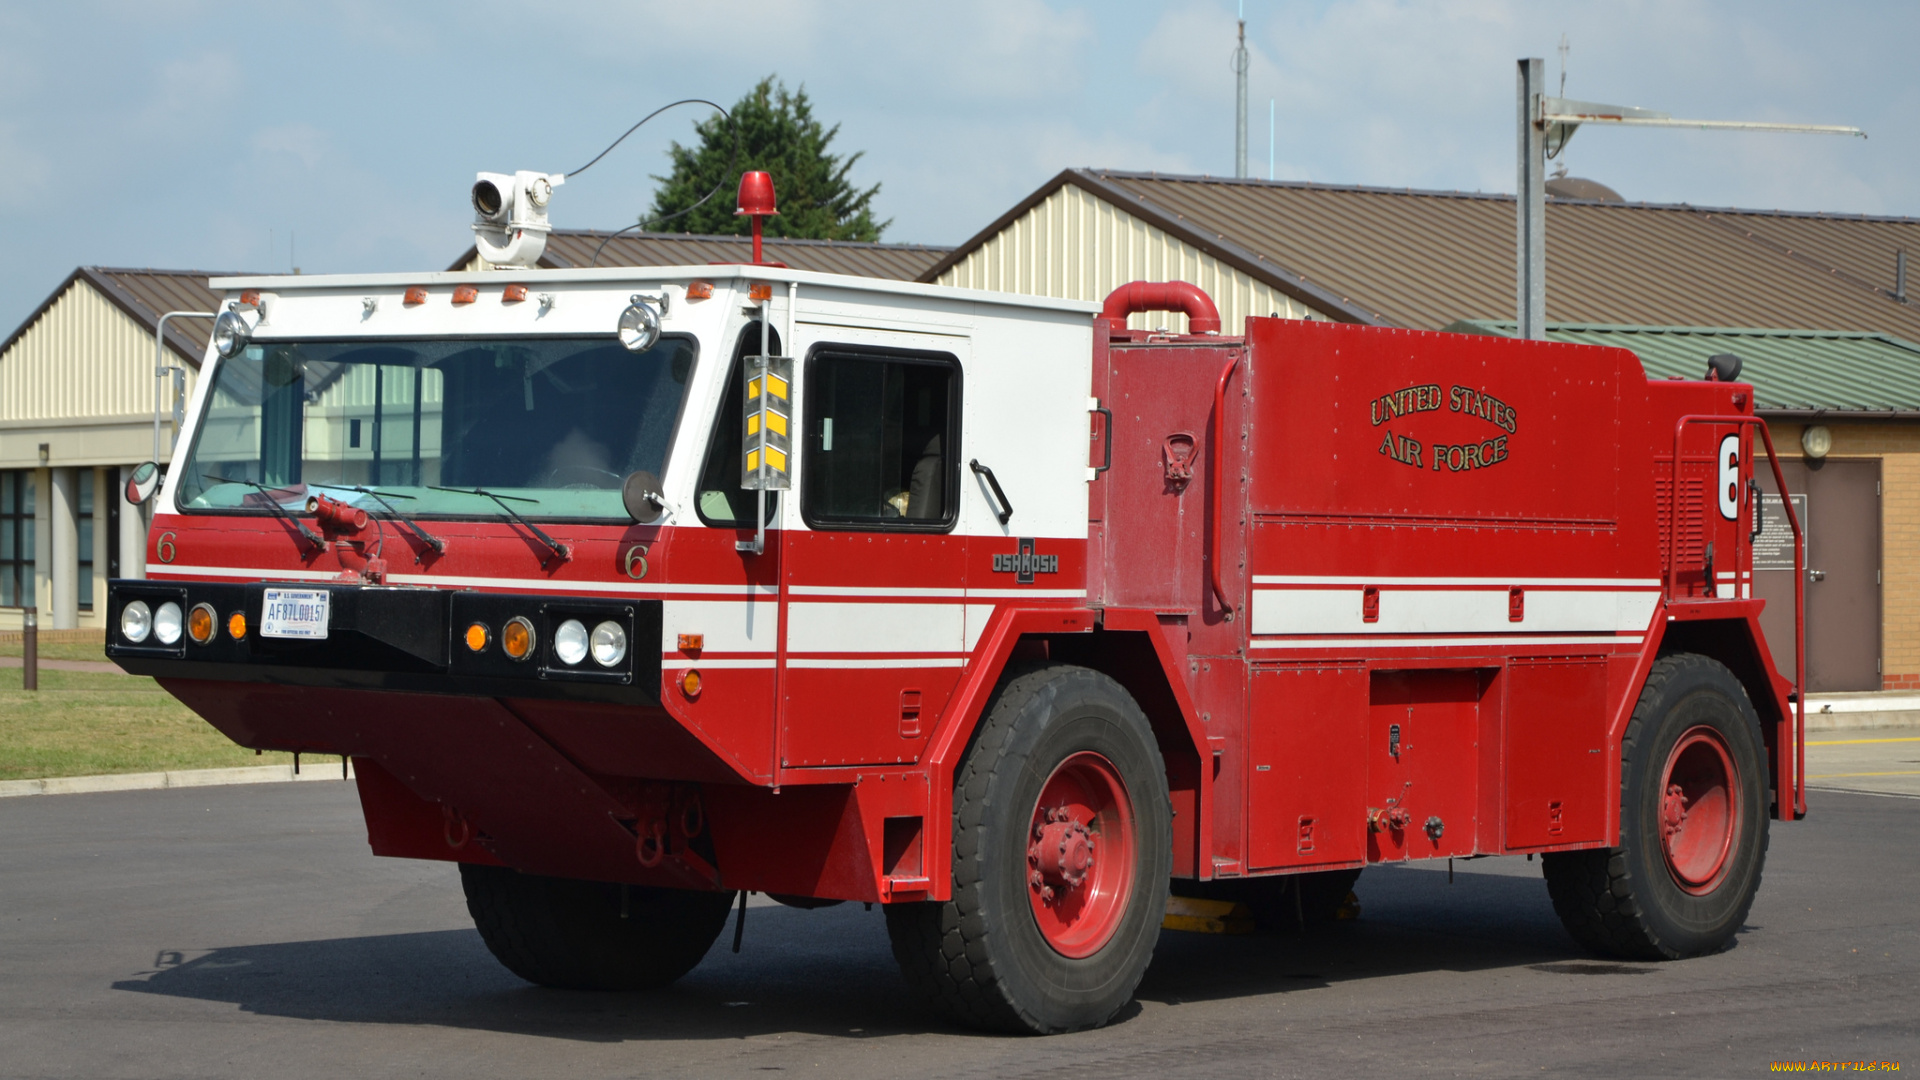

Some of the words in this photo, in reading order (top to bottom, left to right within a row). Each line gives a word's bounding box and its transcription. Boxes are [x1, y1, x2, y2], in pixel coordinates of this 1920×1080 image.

[1370, 384, 1442, 426] UNITED
[1449, 385, 1517, 434] STATES
[1379, 429, 1423, 468] AIR
[1432, 434, 1508, 472] FORCE
[1718, 433, 1747, 521] 6
[156, 531, 177, 564] 6
[625, 545, 649, 580] 6
[992, 554, 1058, 573] OSHKOSH
[268, 603, 324, 621] AF87L00157
